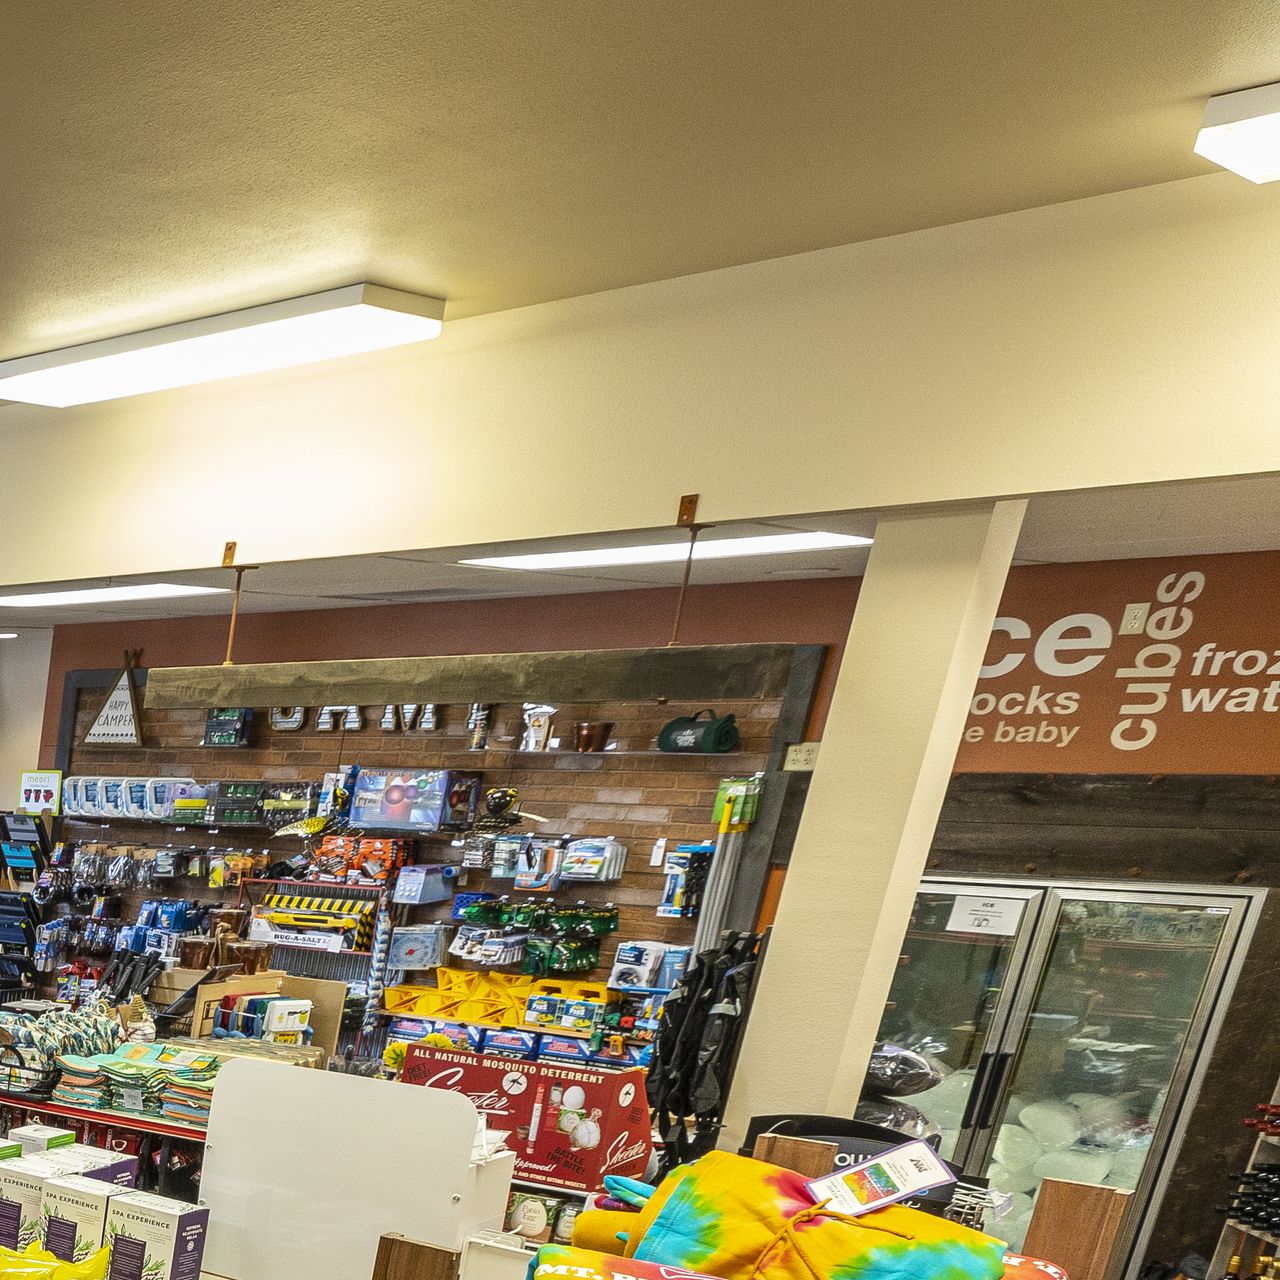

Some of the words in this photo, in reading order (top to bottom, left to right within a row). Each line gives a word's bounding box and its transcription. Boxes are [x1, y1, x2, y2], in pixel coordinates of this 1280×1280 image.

[1110, 571, 1206, 751] cubes
[108, 700, 129, 712] HAPPY
[97, 712, 135, 727] CAMPER
[994, 721, 1080, 748] baby
[273, 933, 322, 944] BUG-A-SALT
[414, 1048, 431, 1059] ALL
[434, 1051, 479, 1066] NATURAL
[483, 1059, 537, 1075] MOSQUITO
[540, 1067, 604, 1084] DETERRENT
[3, 1177, 43, 1193] EXPERIENCE
[45, 1191, 58, 1201] SPA
[59, 1195, 99, 1211] EXPERIENCE
[112, 1209, 125, 1218] SPA
[127, 1213, 170, 1230] EXPERIENCE
